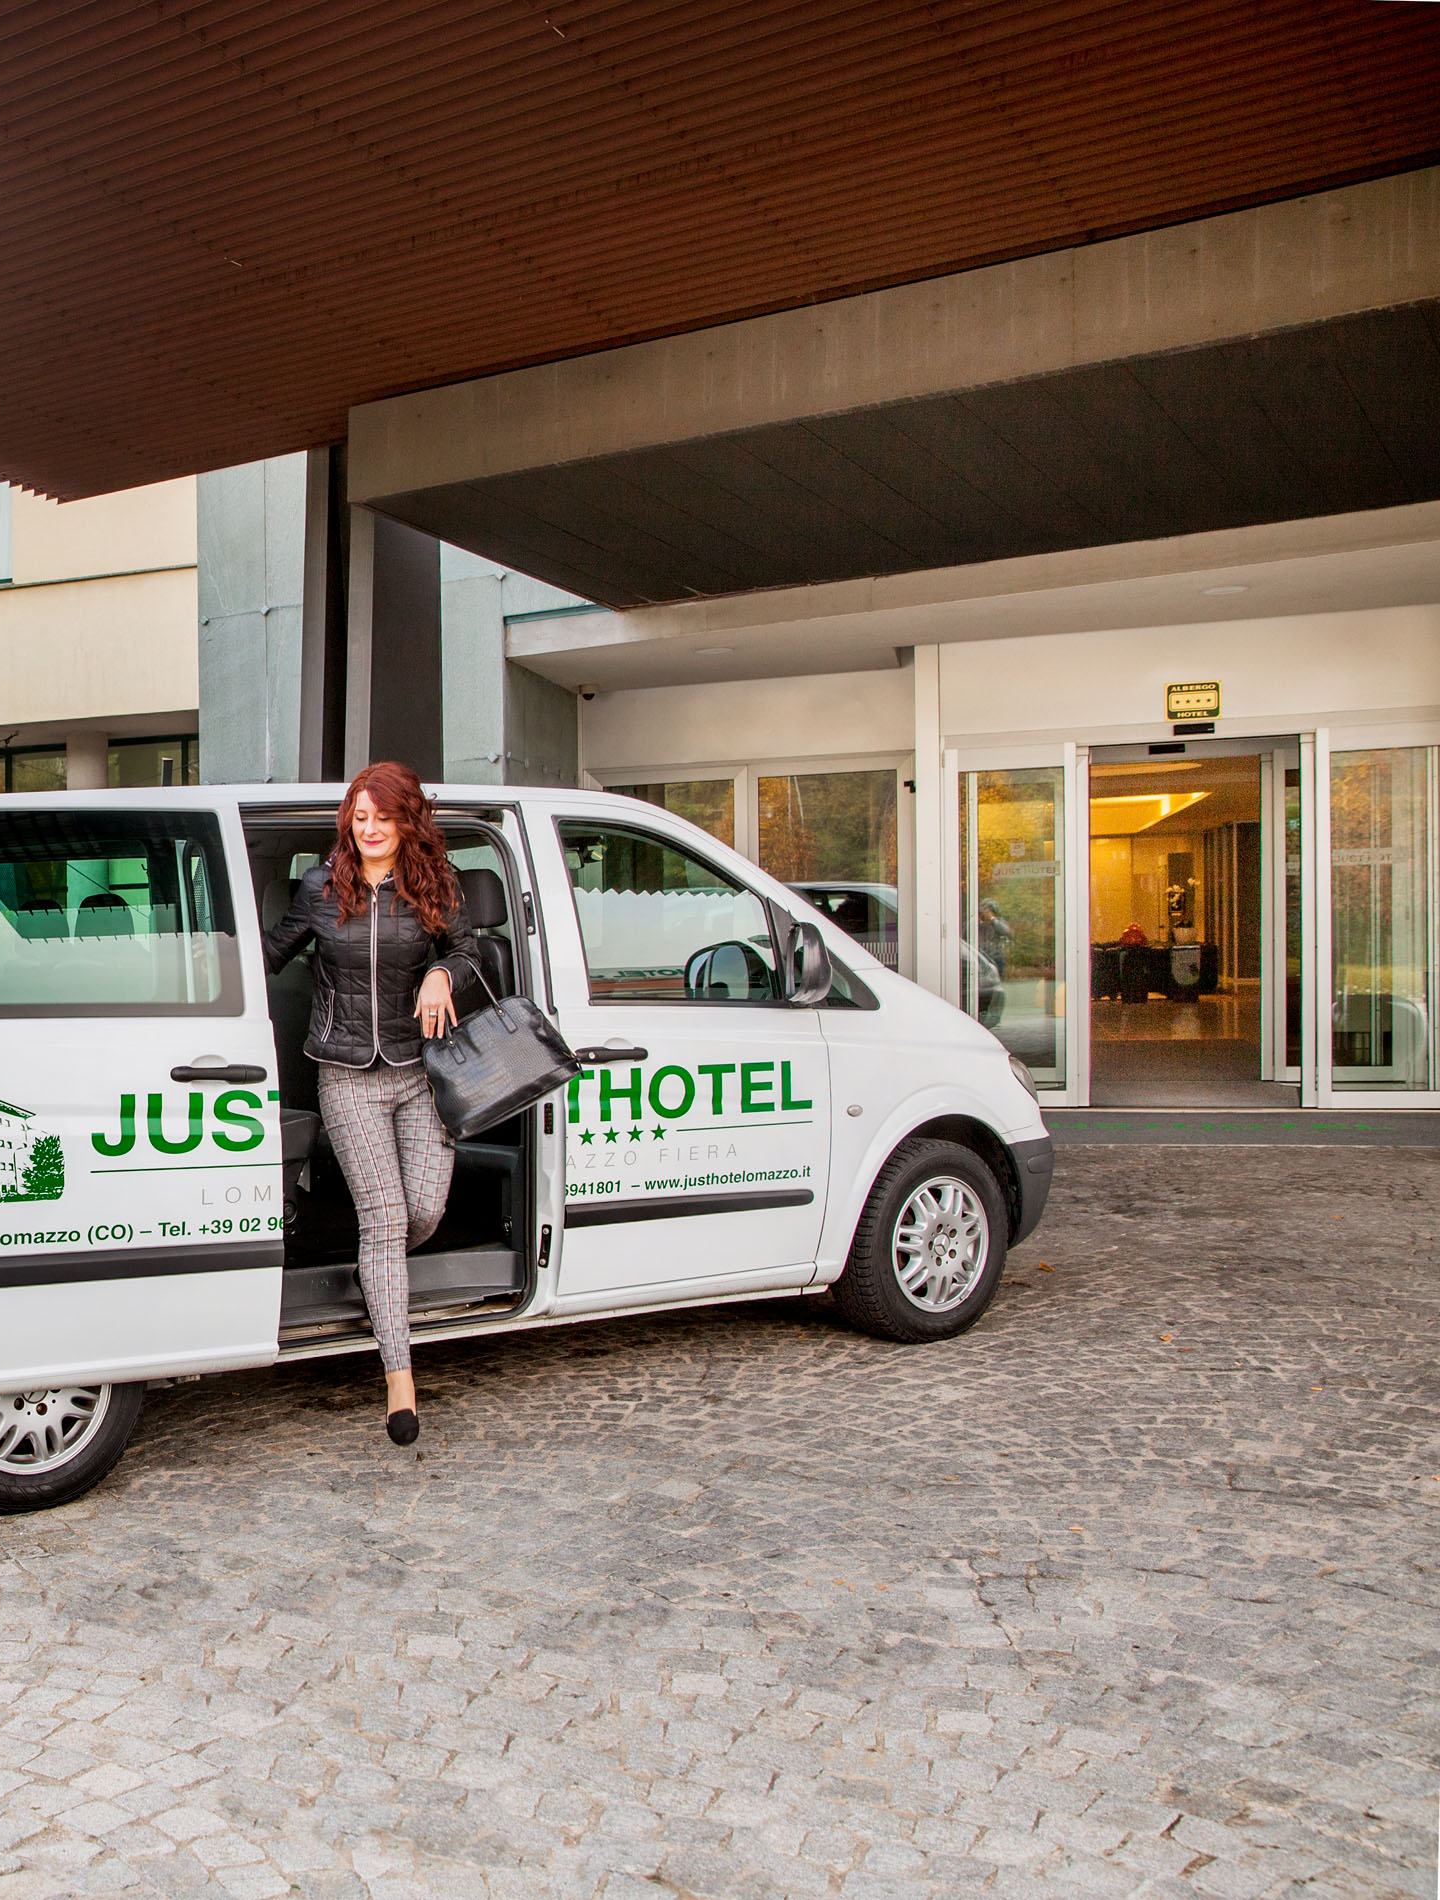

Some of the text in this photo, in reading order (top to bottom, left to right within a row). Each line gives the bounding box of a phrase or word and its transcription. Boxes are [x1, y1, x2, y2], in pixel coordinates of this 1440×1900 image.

[1170, 684, 1216, 692] ALBERGO
[91, 1089, 280, 1157] JUS
[566, 1143, 738, 1170] AZZO FIERA
[644, 1165, 811, 1191] www.justhotelomazzo.it
[201, 1185, 272, 1205] LOM
[87, 1223, 134, 1245] (CO)
[158, 1221, 191, 1237] Tel.
[198, 1219, 233, 1234] +39
[239, 1217, 261, 1232] 02
